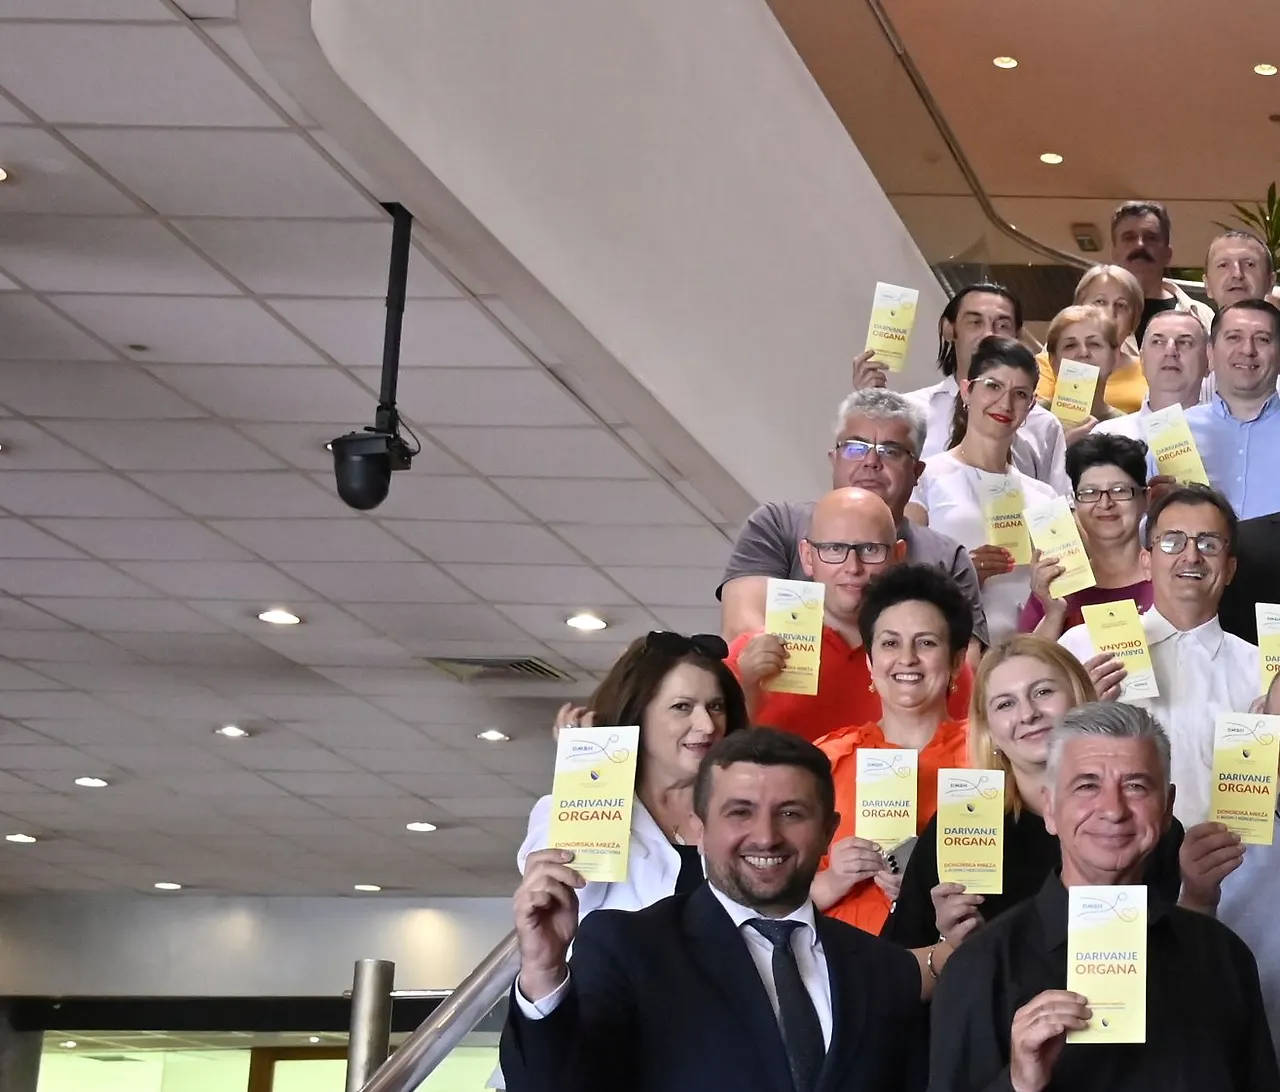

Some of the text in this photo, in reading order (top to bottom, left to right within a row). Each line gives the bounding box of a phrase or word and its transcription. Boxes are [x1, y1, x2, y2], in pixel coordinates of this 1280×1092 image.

[872, 331, 906, 342] ORGANA
[1056, 401, 1085, 413] ORGANA
[1159, 447, 1192, 463] ORGANA
[784, 641, 815, 652] GANA
[1099, 639, 1142, 652] ORGANA
[1112, 648, 1144, 658] DARIVA
[1218, 772, 1271, 784] DARIVANJE
[1217, 783, 1270, 795] ORGANA
[559, 798, 625, 809] DARIVANJE
[862, 799, 911, 808] DARIVANJE
[557, 810, 623, 822] ORGANA
[862, 808, 910, 818] ORGANA
[943, 827, 998, 837] DARIVANJE
[943, 836, 997, 847] ORGANA
[1075, 951, 1138, 962] DARIVANJE
[1074, 963, 1137, 976] ORGANA
